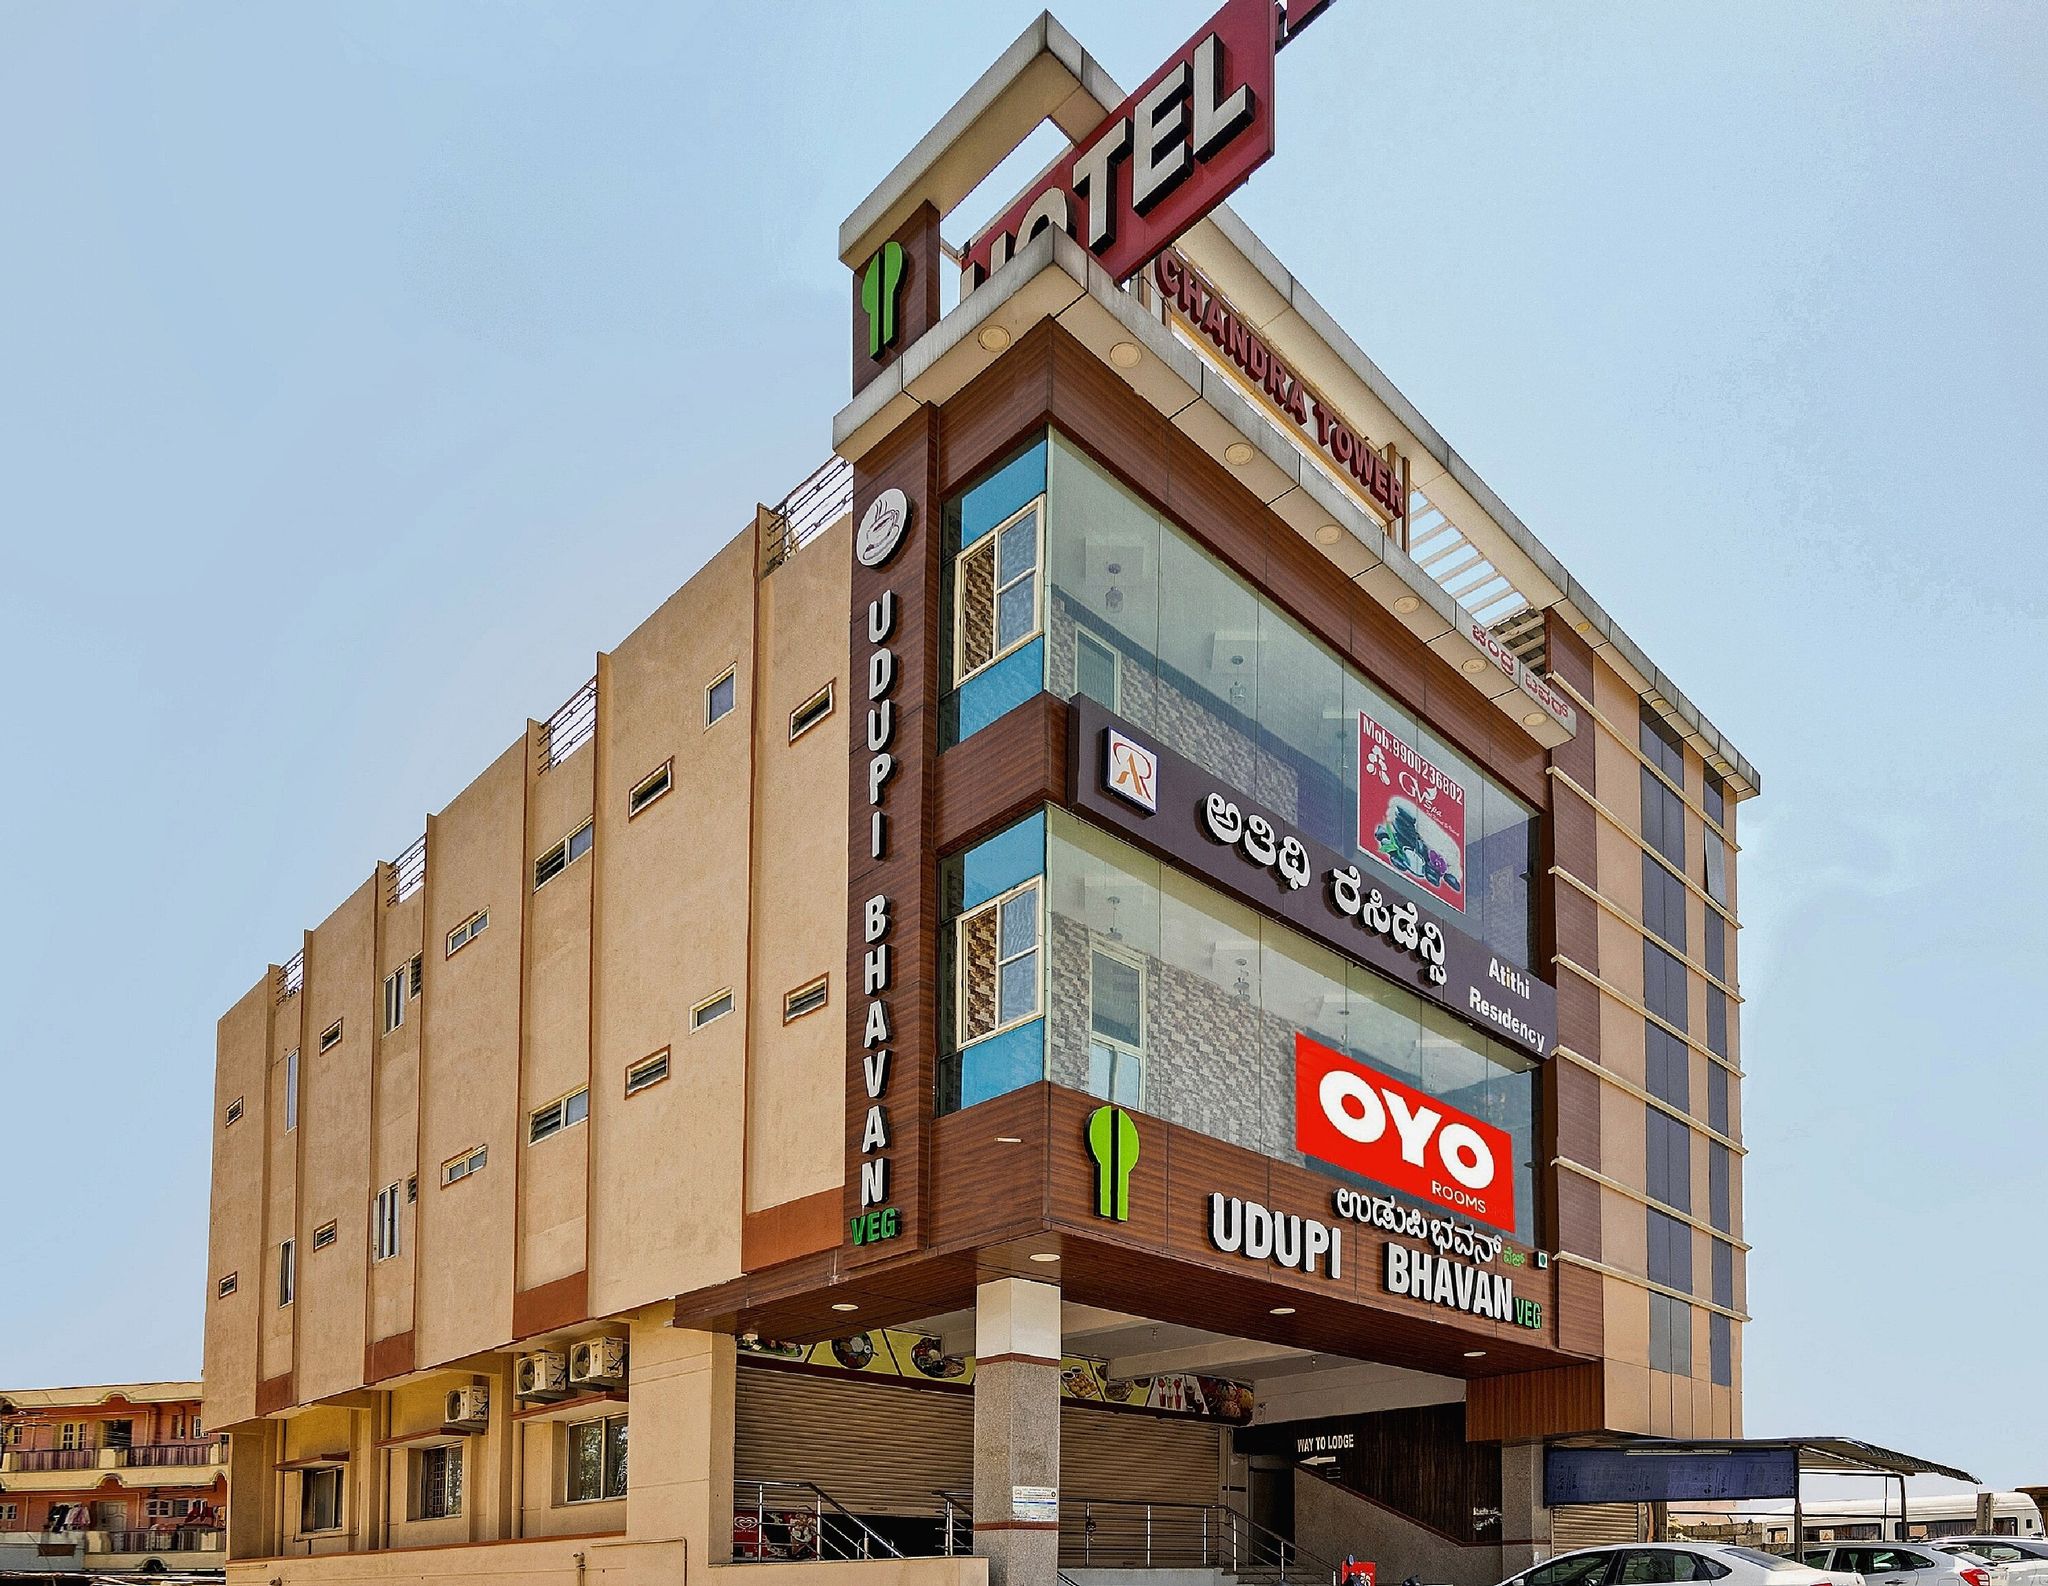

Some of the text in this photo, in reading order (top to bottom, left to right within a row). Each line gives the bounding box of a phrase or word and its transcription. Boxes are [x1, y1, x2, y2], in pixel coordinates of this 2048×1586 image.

[961, 32, 1255, 299] TEL
[1155, 248, 1404, 518] CHANDRA TOWER
[1206, 792, 1312, 891] ಅತಿಥಿ
[850, 589, 899, 1246] UDUPI BHAVAN VEG
[1469, 986, 1545, 1053] Residency
[1488, 957, 1530, 1000] Atithi
[1318, 1070, 1495, 1190] OYO
[1210, 1192, 1341, 1279] UDUPI
[1336, 1187, 1427, 1240] ಉಡುಪಿ
[1431, 1180, 1487, 1214] ROOMS
[1386, 1241, 1543, 1330] BHAVAN VEG
[1297, 1434, 1354, 1453] WAY TO LODGE
